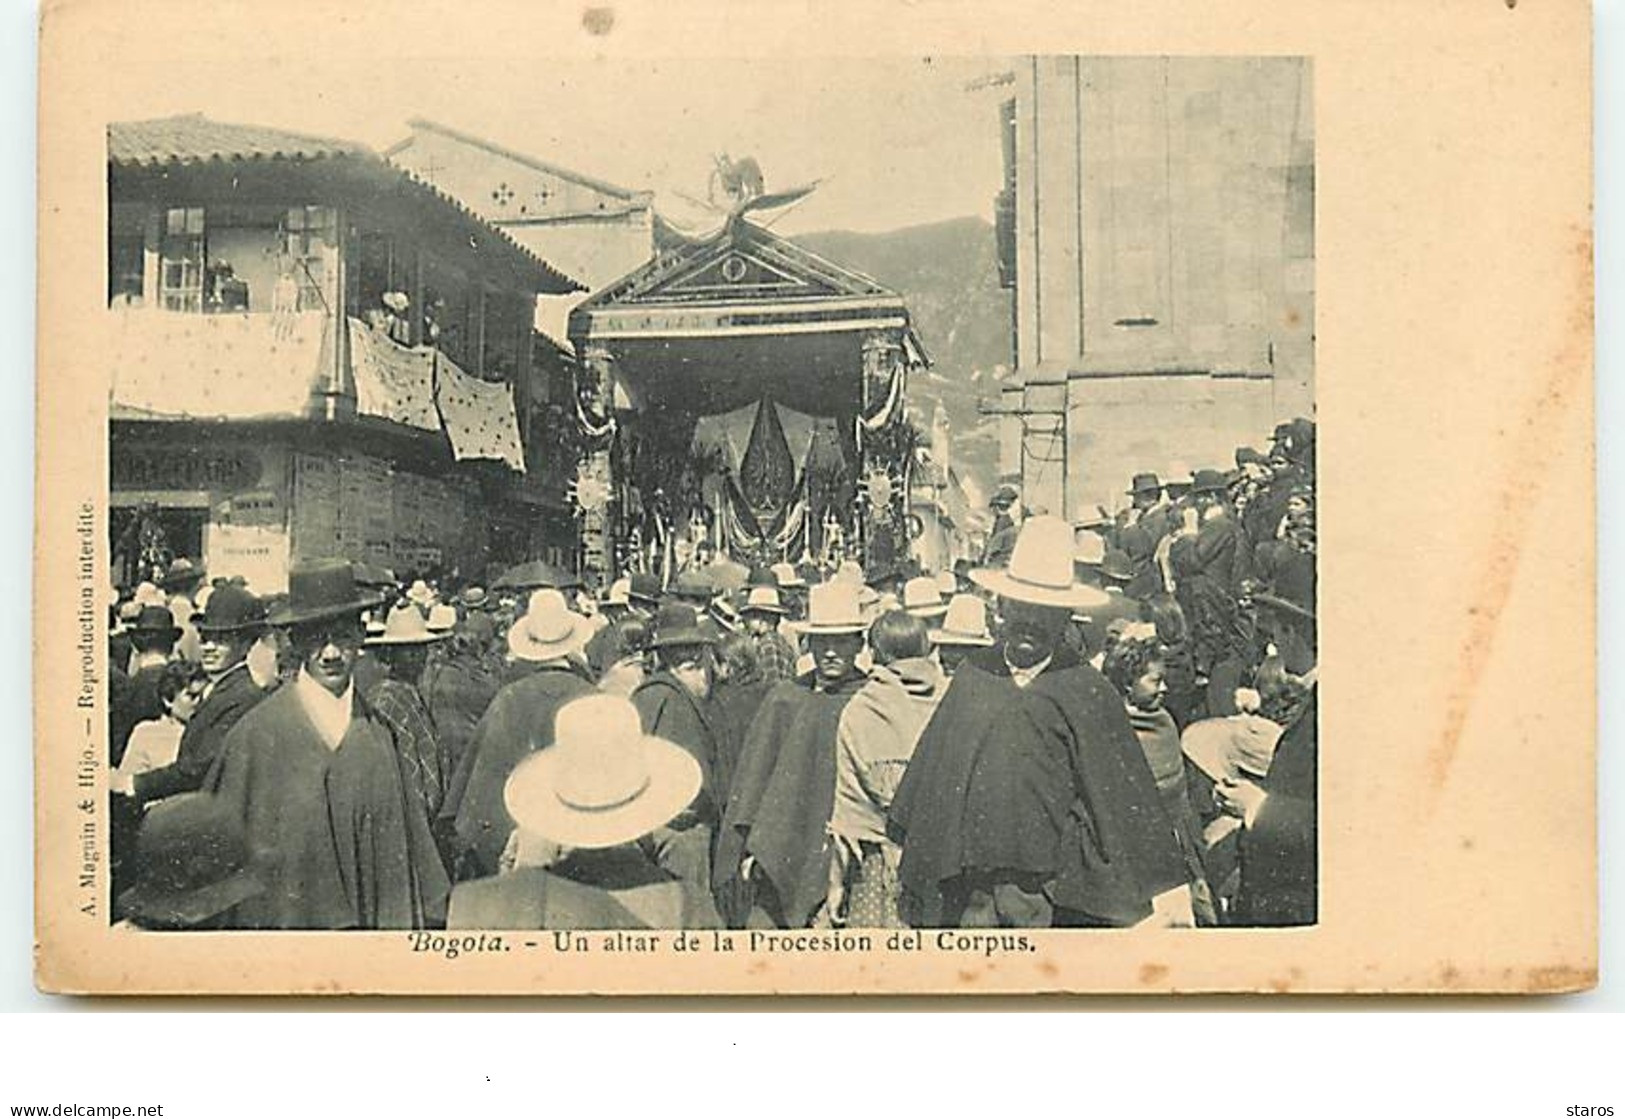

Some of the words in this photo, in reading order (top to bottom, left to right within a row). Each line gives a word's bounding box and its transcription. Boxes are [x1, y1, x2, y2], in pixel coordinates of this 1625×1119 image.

[77, 587, 99, 709] Reproduction
[77, 799, 95, 815] &
[80, 897, 97, 917] A.
[407, 932, 510, 959] Bogota.
[554, 931, 588, 952] Un
[603, 931, 660, 952] altar
[673, 931, 700, 952] de
[714, 931, 734, 952] la
[750, 931, 871, 952] Procesion
[886, 931, 922, 952] del
[936, 931, 1036, 957] Corpus.
